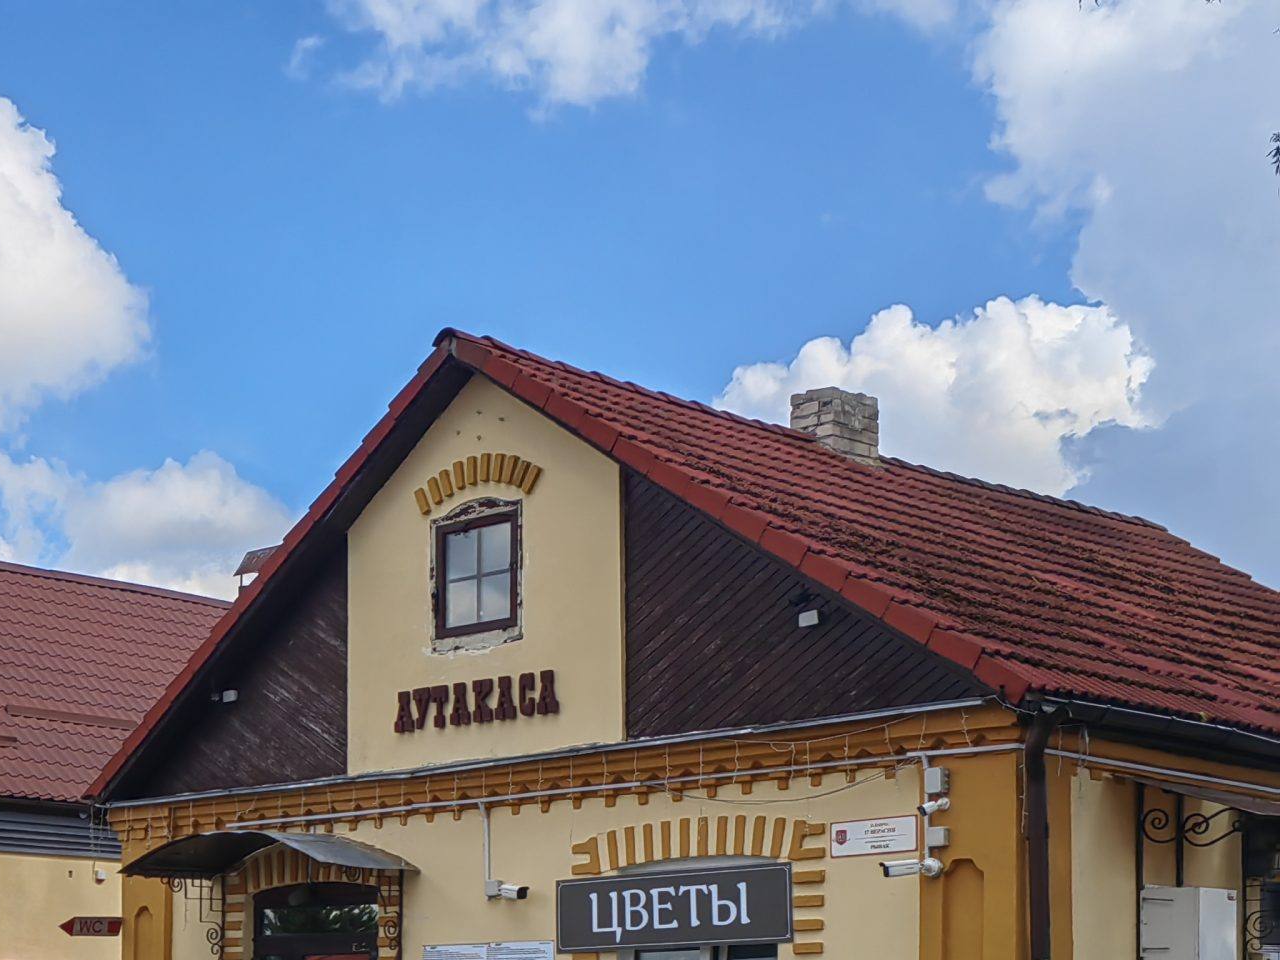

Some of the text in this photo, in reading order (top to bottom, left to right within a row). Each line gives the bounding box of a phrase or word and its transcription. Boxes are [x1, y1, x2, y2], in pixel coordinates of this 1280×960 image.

[394, 669, 560, 734] АУТАКАСА
[79, 920, 103, 933] WC
[589, 881, 751, 944] ЦВЕТЫ
